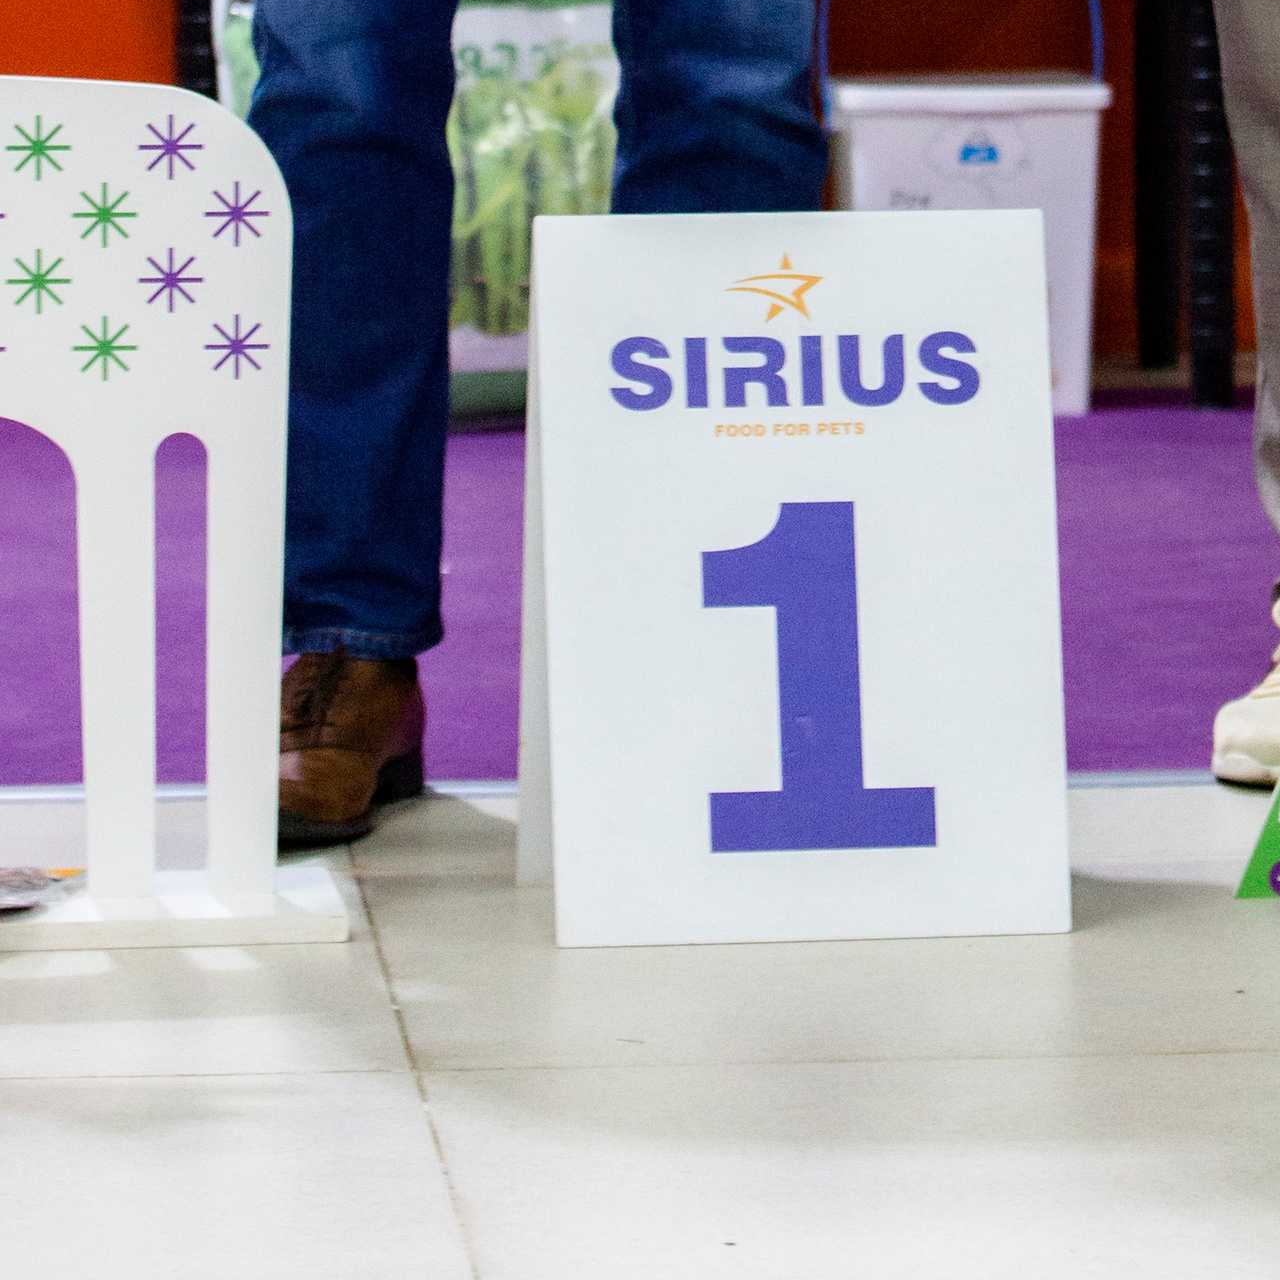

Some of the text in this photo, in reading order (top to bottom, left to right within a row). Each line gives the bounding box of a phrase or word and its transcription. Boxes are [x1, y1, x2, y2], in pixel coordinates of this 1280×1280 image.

[610, 331, 980, 411] SIRIUS
[714, 422, 865, 437] FOOD FOR PETS
[701, 501, 937, 853] 1
